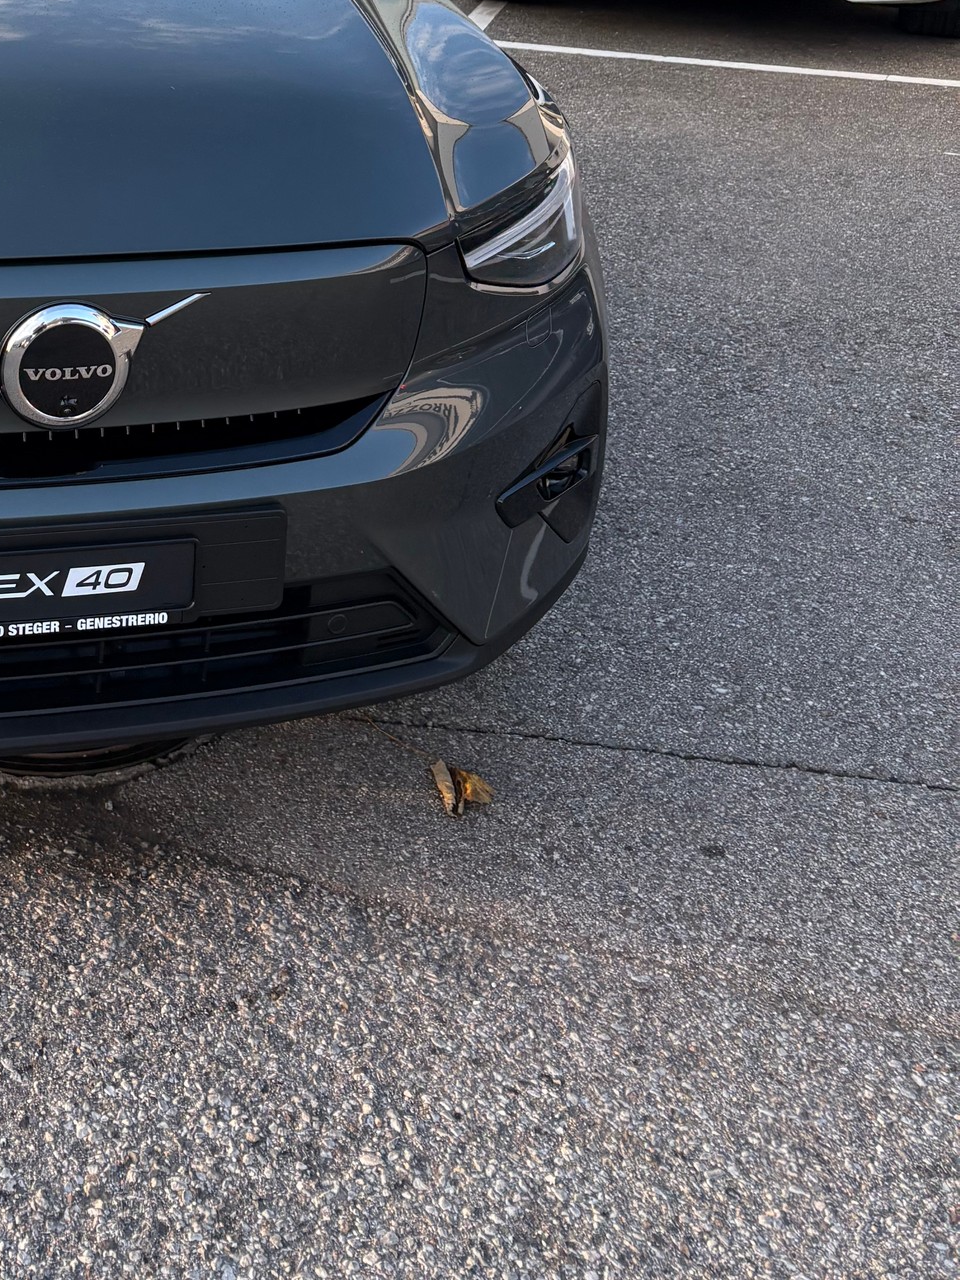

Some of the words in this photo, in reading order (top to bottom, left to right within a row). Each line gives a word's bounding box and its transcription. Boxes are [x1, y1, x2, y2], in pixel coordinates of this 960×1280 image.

[23, 364, 113, 381] VOLVO
[8, 621, 60, 636] STEGER
[77, 612, 168, 631] GENESTRERIO
